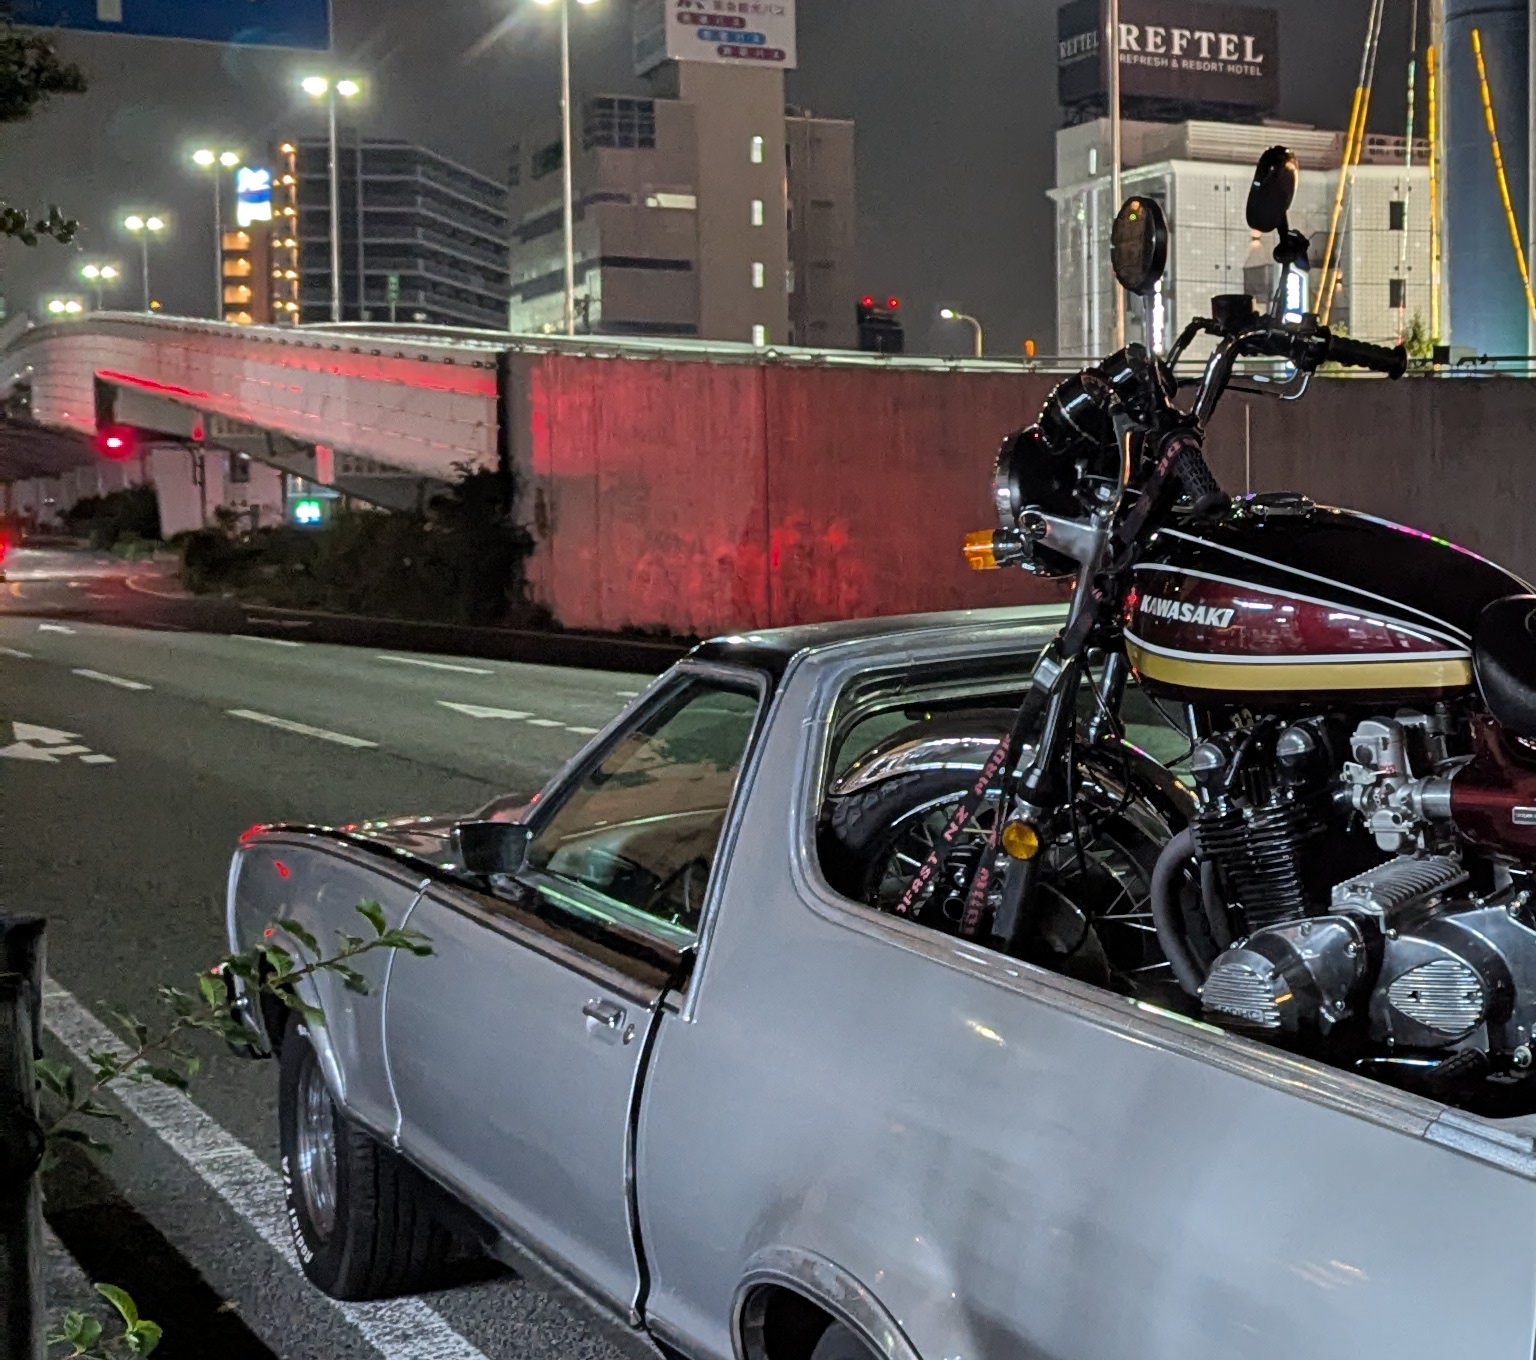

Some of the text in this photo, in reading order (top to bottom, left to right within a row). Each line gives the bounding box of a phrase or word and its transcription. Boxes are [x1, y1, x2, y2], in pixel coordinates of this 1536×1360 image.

[1058, 30, 1100, 61] REFTEL
[1118, 23, 1264, 64] REFTEL
[1119, 53, 1264, 77] REFRESH & RESORT HOTEL
[1140, 594, 1235, 628] KAWASAKI
